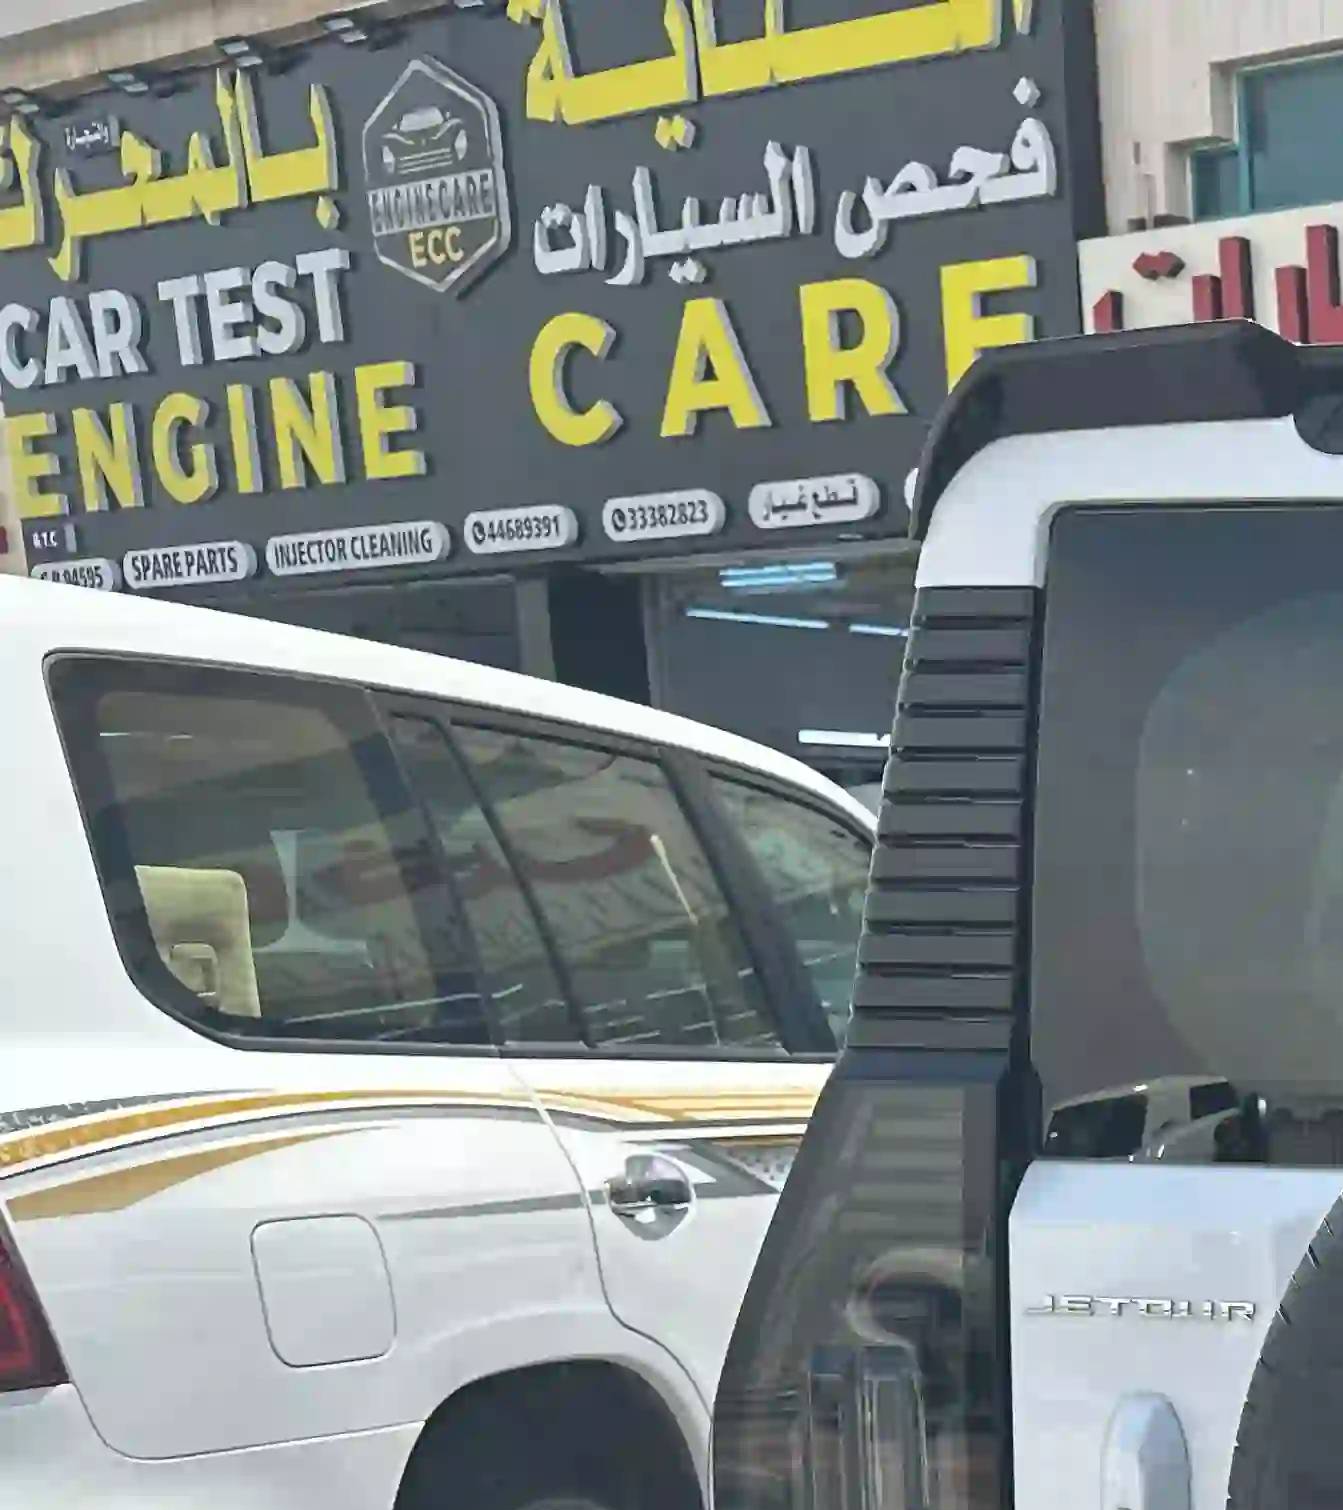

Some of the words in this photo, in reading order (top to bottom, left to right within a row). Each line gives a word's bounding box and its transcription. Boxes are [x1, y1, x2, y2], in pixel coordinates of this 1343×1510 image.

[834, 76, 1057, 258] فحص
[534, 140, 814, 285] السيارات
[408, 225, 465, 268] ECC
[0, 289, 148, 389] CAR
[158, 248, 350, 366] TEST
[3, 360, 427, 517] ENGINE
[273, 537, 347, 568] INJECTOR
[350, 527, 433, 561] CLEANING
[487, 514, 561, 541] 44689391
[131, 548, 183, 581] SPARE
[186, 545, 238, 577] PARTS
[1024, 1294, 1257, 1321] JETOUR
